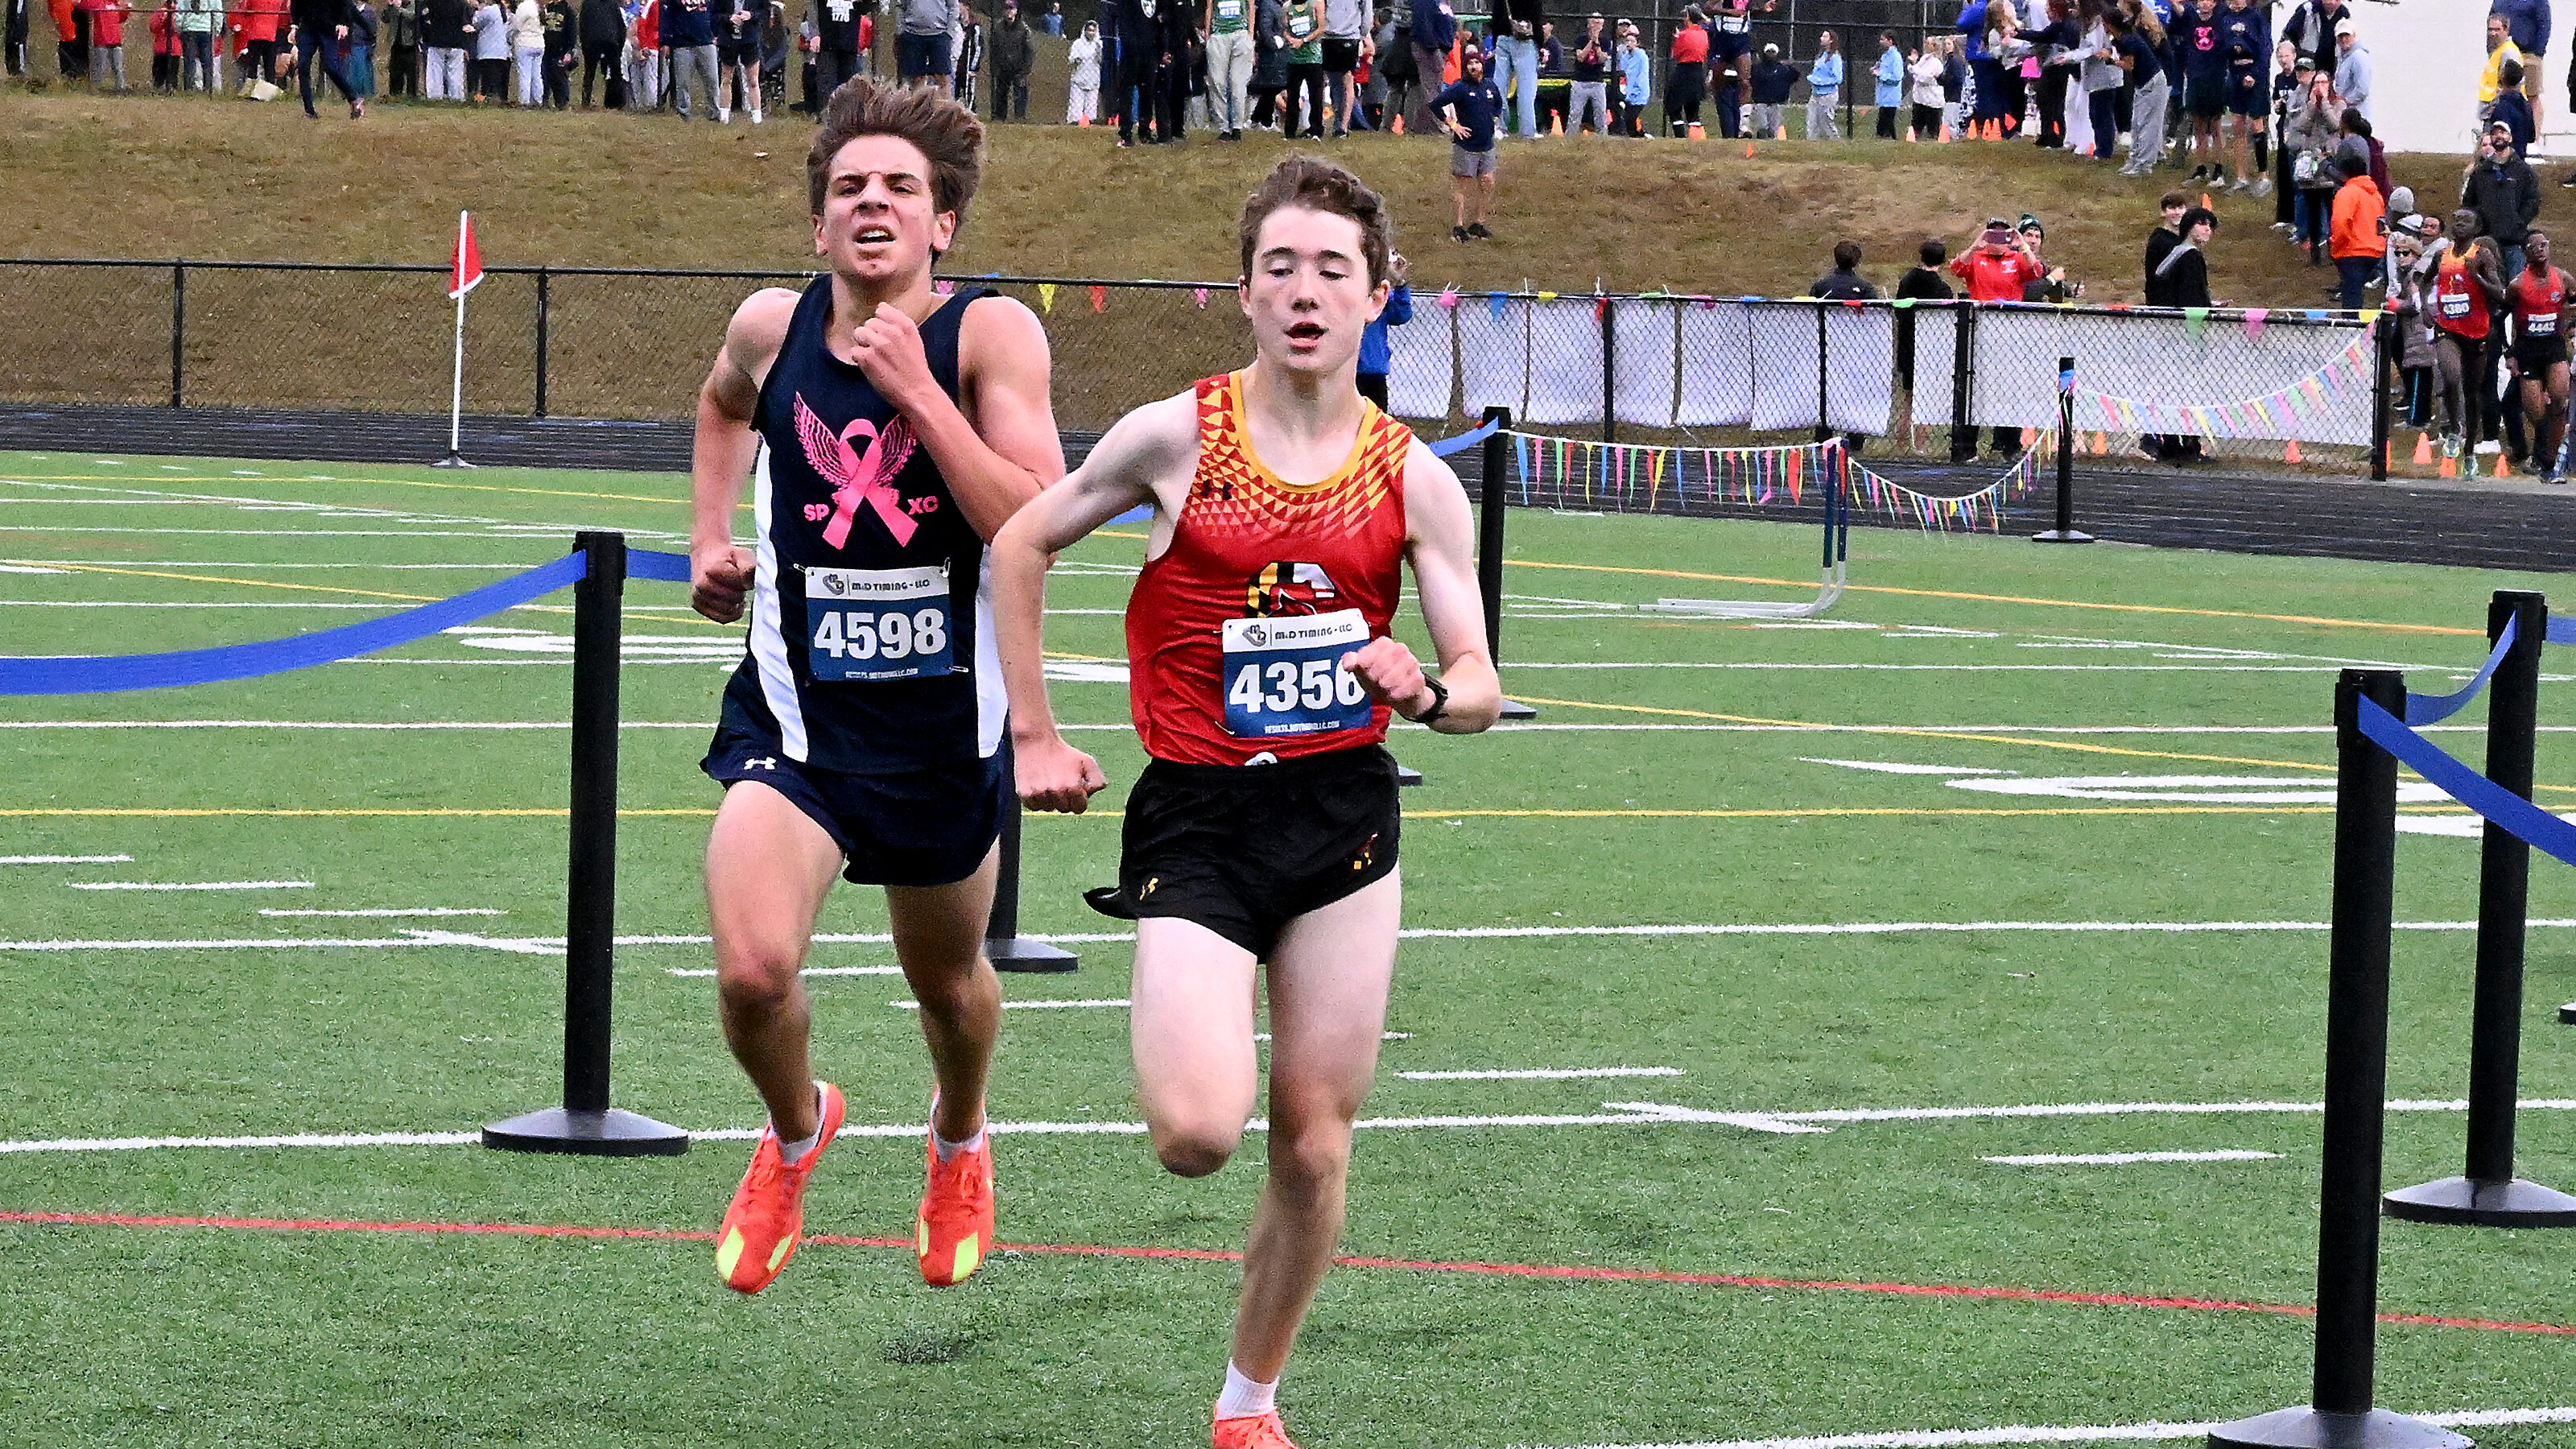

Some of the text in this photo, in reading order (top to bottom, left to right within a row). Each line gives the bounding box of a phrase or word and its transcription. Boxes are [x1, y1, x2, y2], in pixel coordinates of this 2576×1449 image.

[804, 503, 829, 521] SP
[907, 496, 939, 514] XC
[873, 581, 908, 591] TIMING
[814, 609, 947, 659] 4598
[1298, 627, 1332, 638] TIMING
[1229, 658, 1366, 713] 4356
